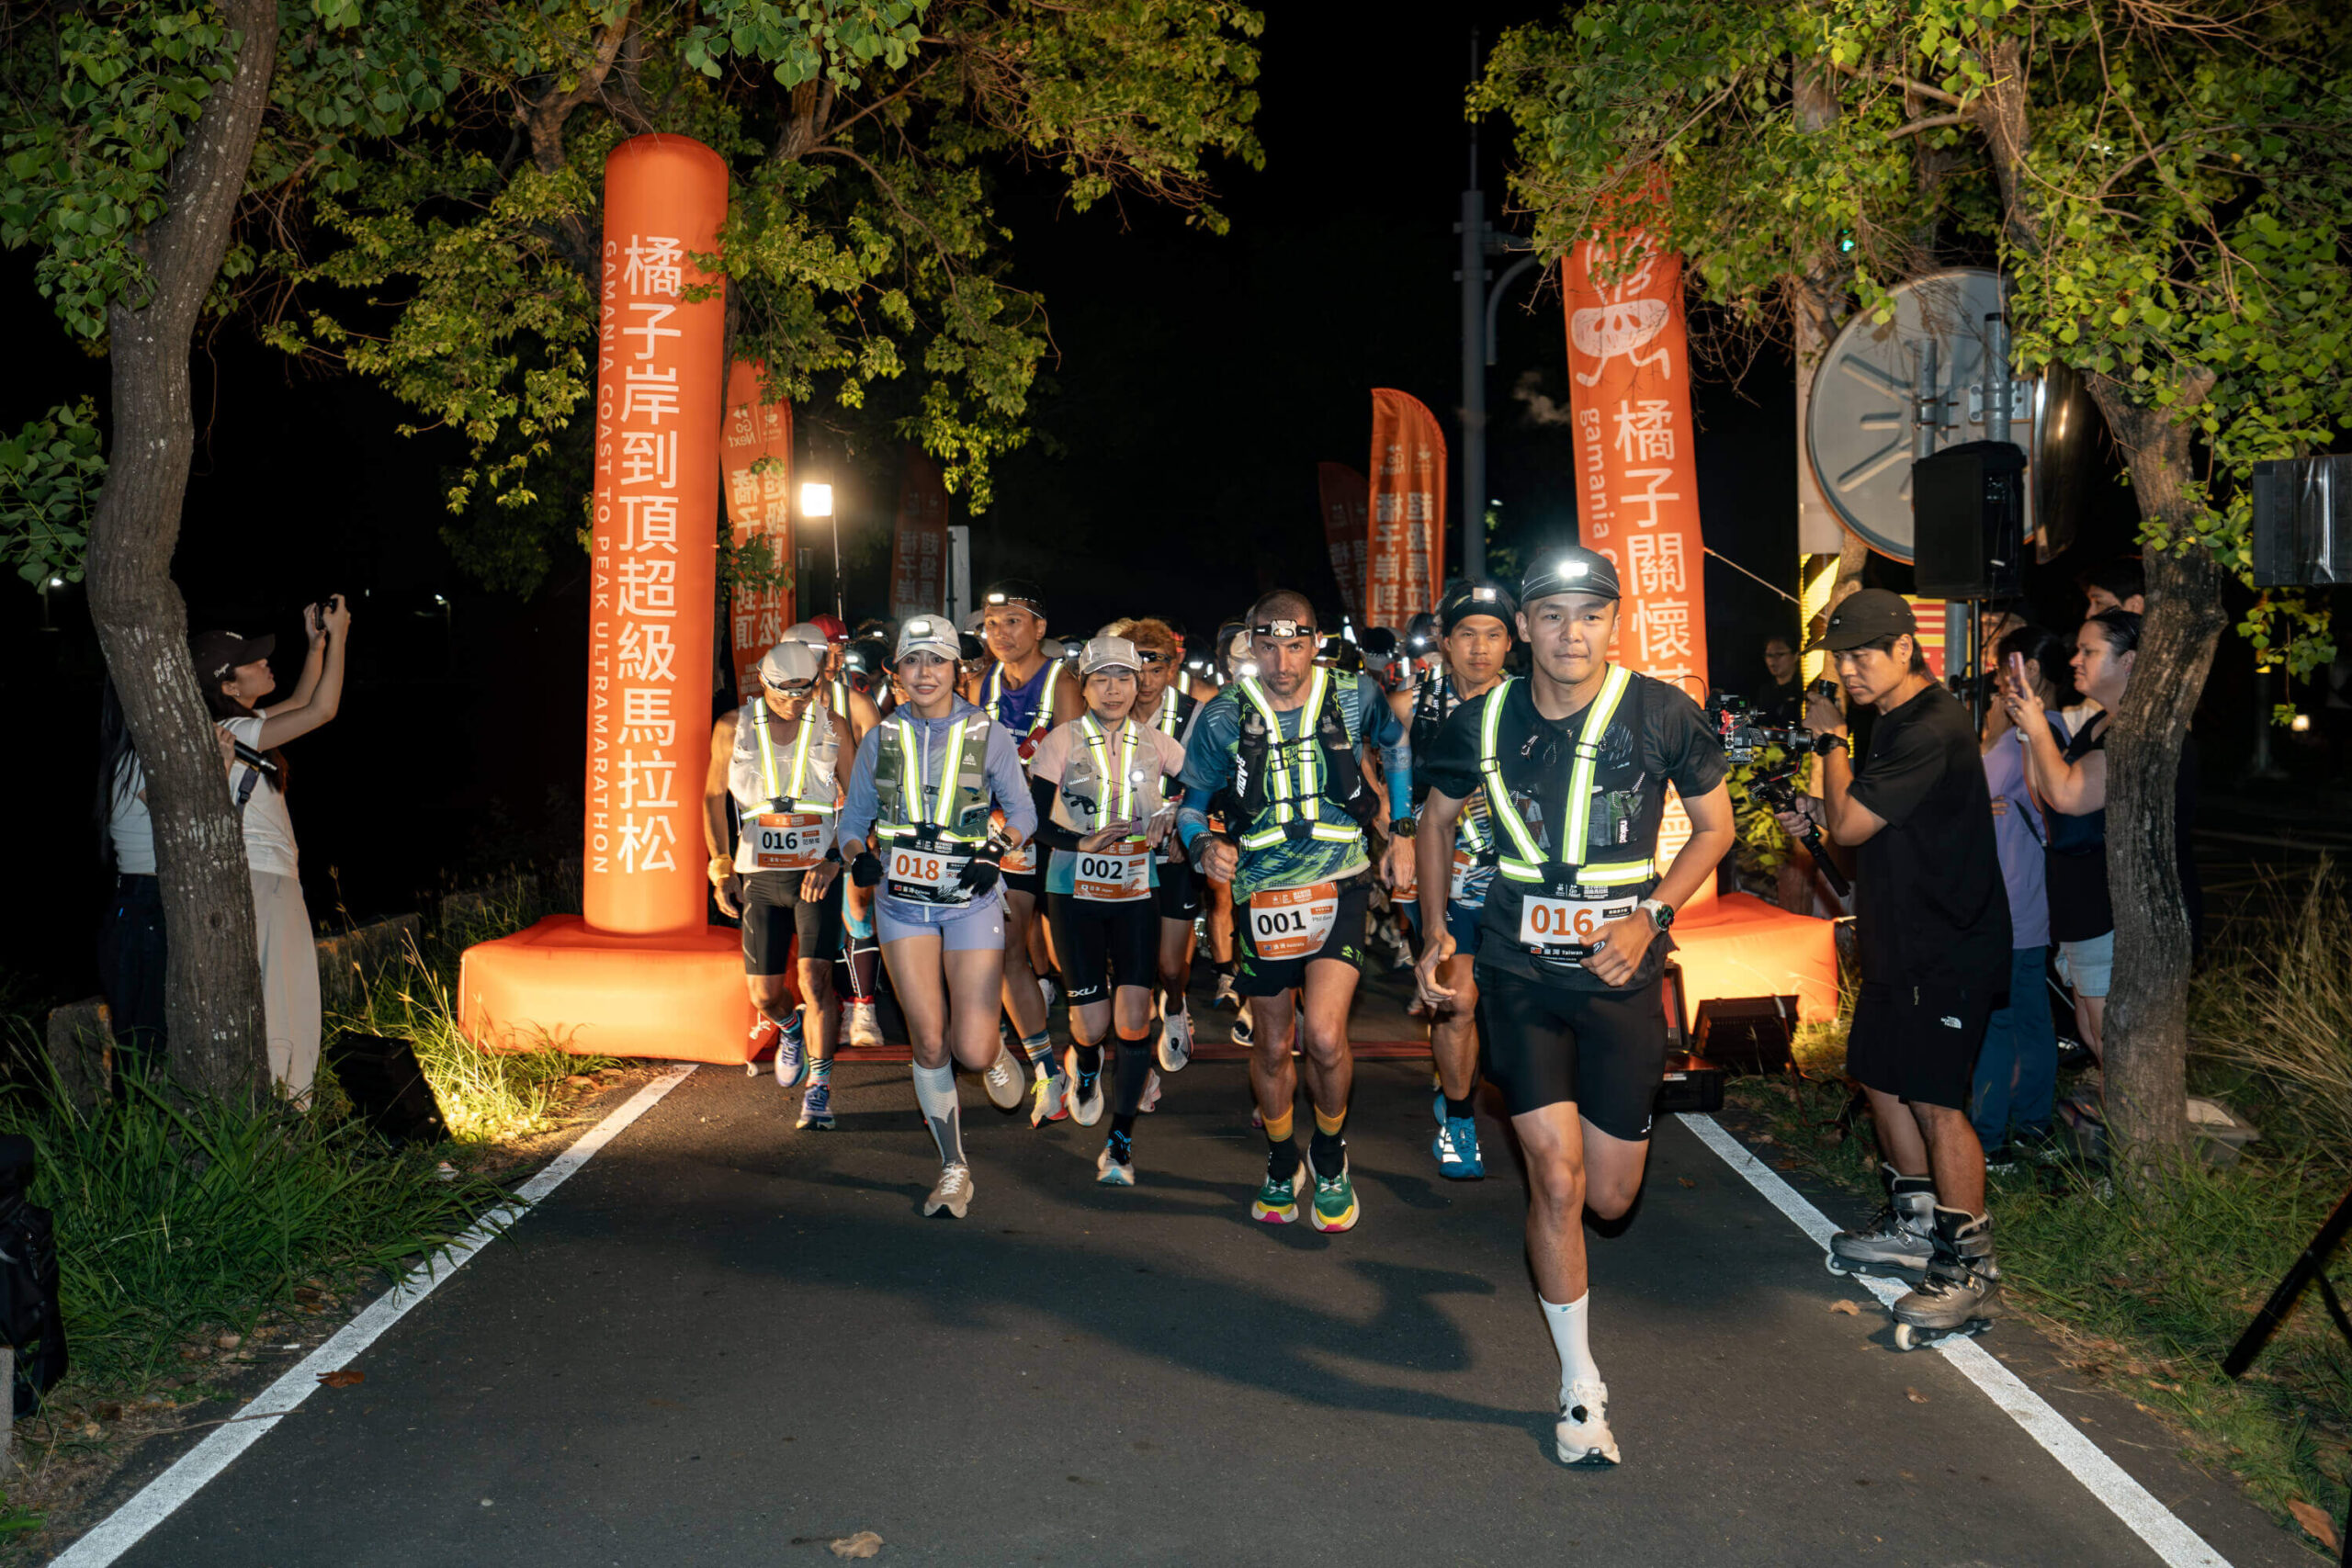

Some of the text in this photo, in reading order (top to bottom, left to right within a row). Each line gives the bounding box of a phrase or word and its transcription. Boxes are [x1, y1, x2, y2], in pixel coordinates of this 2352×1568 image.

[1579, 407, 1614, 539] gamania
[593, 241, 616, 874] GAMANIA COAST TO PEAK ULTRAMARATHON
[617, 234, 683, 874] 橘子岸到頂超級馬拉松
[762, 830, 798, 850] 016
[896, 853, 940, 881] 018
[1081, 857, 1123, 880] 002
[1257, 910, 1307, 936] 001
[1531, 904, 1594, 936] 016
